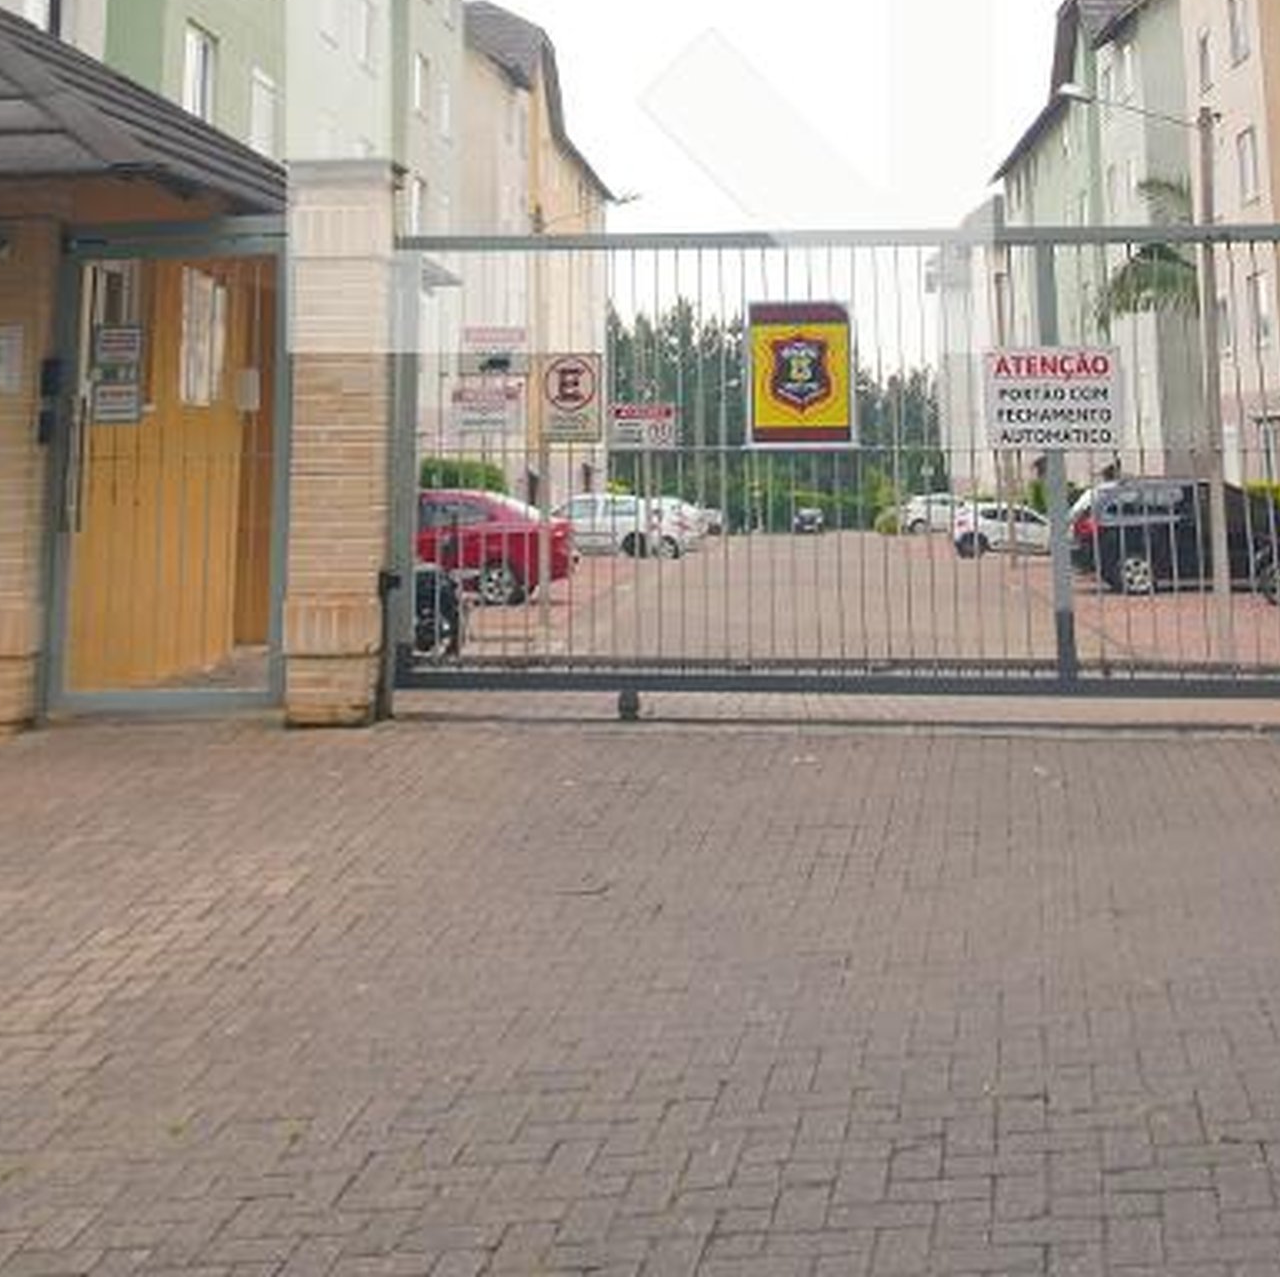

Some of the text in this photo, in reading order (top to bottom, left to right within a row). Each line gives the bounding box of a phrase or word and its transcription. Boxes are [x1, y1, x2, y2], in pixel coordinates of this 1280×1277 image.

[995, 352, 1109, 382] ATENÇÃO
[556, 367, 585, 402] E
[1070, 386, 1109, 401] COM
